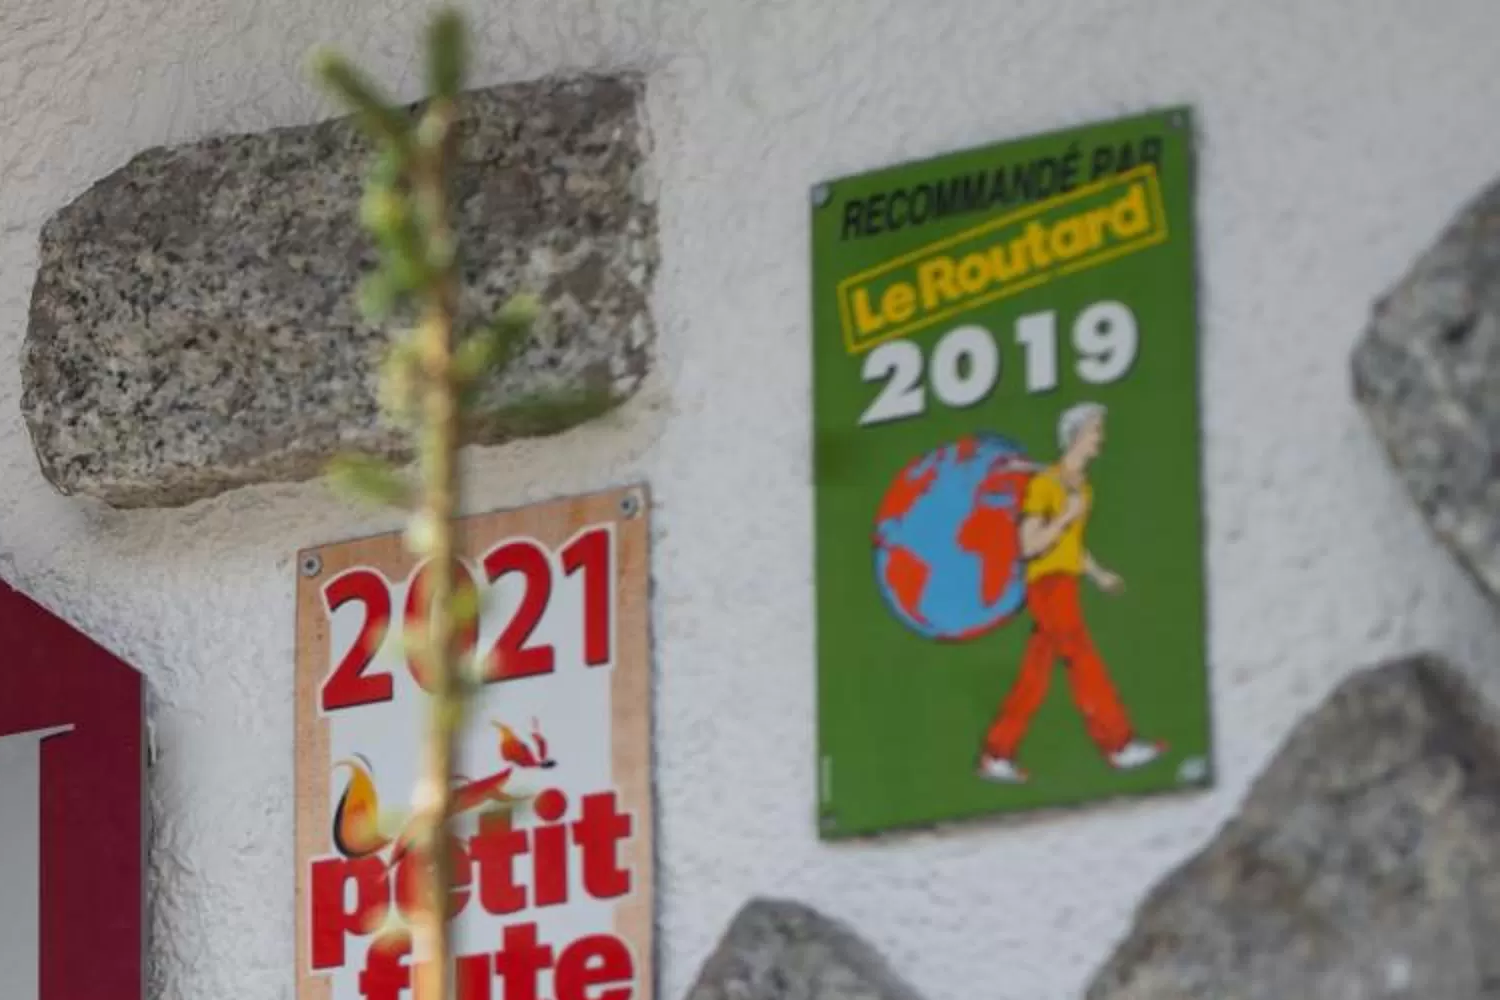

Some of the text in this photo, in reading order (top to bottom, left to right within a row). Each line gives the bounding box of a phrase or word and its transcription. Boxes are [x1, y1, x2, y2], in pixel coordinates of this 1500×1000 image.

[840, 136, 1164, 241] RECOMMANDÉ PAR
[858, 300, 1139, 427] 2019
[321, 527, 610, 712] 2021
[311, 788, 632, 970] petit
